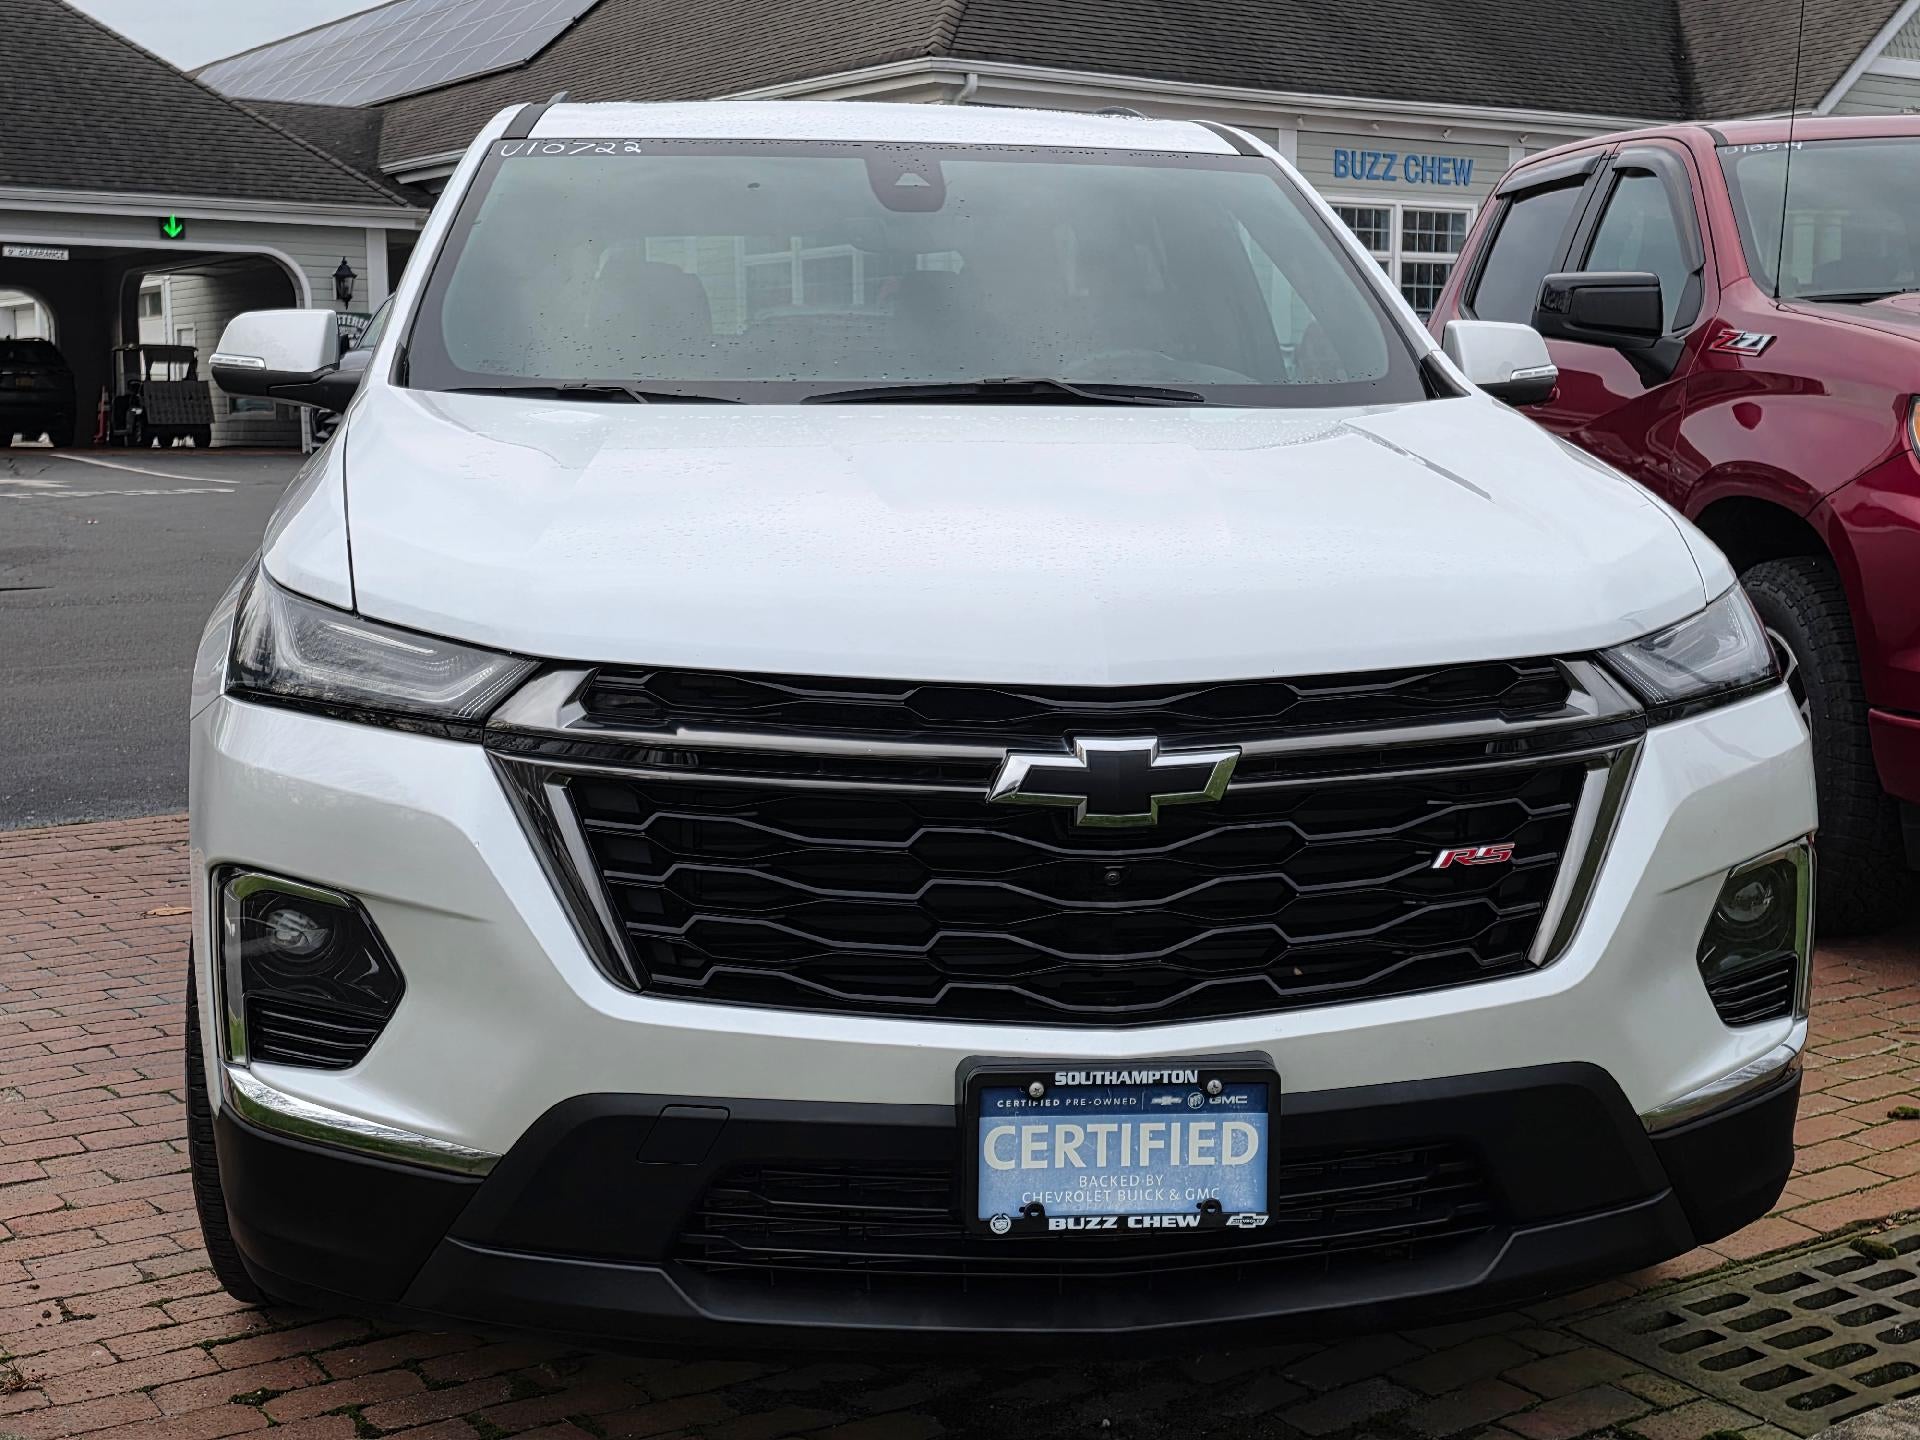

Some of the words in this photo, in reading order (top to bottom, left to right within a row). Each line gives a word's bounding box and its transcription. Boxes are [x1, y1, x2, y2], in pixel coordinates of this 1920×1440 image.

[1334, 149, 1398, 181] BUZZ
[1404, 154, 1474, 186] CHEW
[1432, 842, 1515, 868] RS
[1055, 1070, 1198, 1086] SOUTHAMPTON
[997, 1099, 1060, 1108] CERTIFIED
[1065, 1097, 1137, 1107] PRE-OWNED
[1209, 1095, 1248, 1105] GMC
[983, 1121, 1259, 1170] CERTIFIED
[1079, 1175, 1140, 1188] BACKED
[1146, 1174, 1164, 1186] BY
[1022, 1189, 1111, 1204] CHEVROLET
[1118, 1188, 1164, 1202] BUICK
[1169, 1188, 1179, 1201] &
[1185, 1187, 1220, 1201] GMC
[1048, 1217, 1118, 1231] BUZZ
[1127, 1215, 1201, 1229] CHEW
